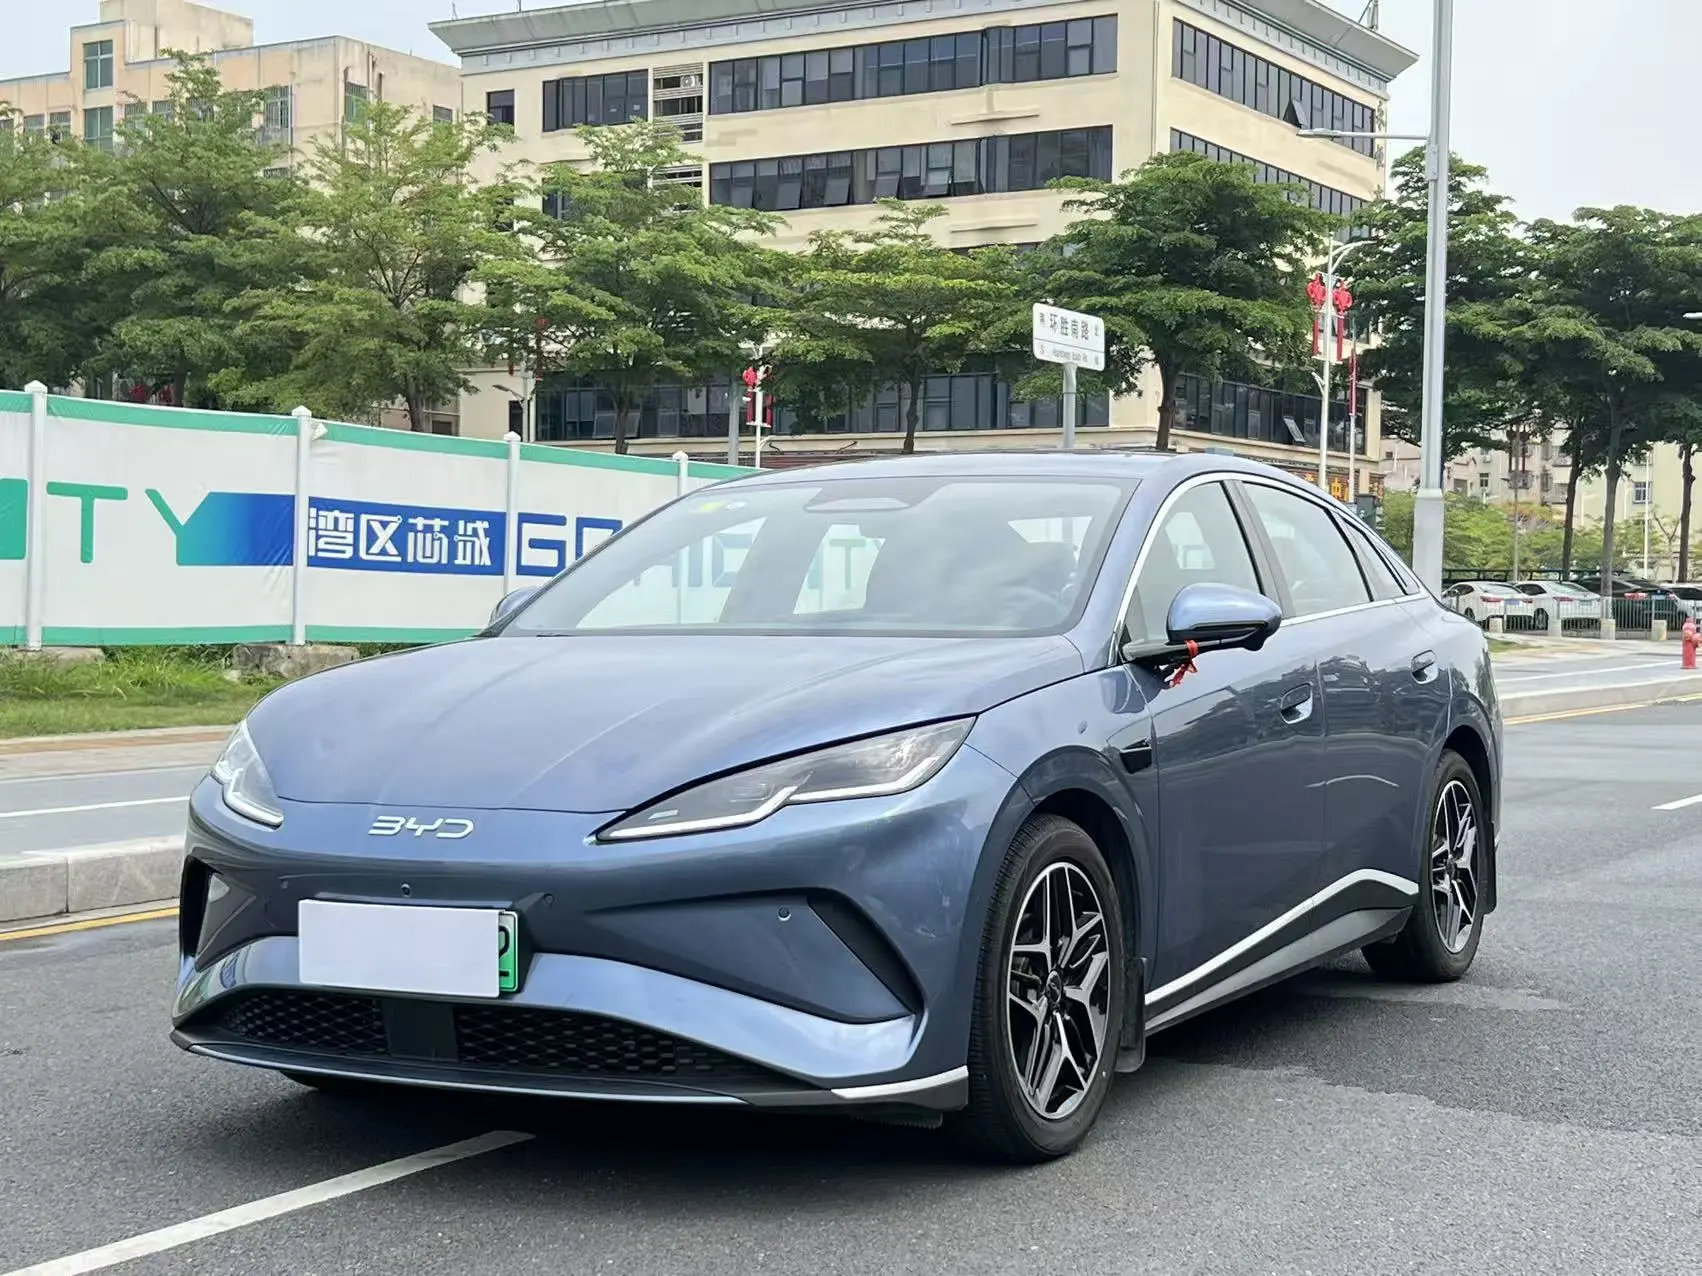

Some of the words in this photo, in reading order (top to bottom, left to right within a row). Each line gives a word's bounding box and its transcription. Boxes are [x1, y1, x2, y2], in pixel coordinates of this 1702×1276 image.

[308, 507, 492, 566] 湾区芯城
[368, 815, 474, 838] BYD
